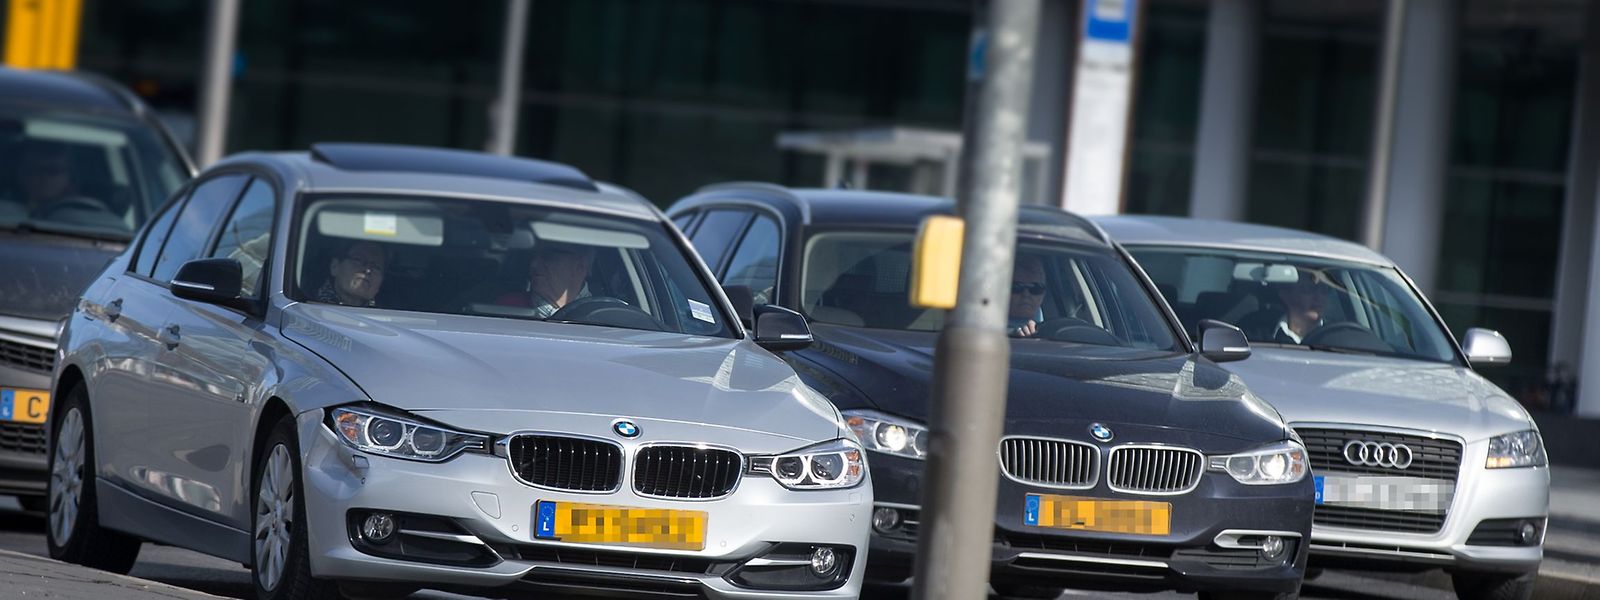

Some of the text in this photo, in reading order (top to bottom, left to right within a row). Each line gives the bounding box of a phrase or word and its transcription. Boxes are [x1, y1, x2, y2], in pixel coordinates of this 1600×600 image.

[28, 396, 48, 418] C
[1028, 512, 1035, 522] L
[543, 521, 550, 531] L
